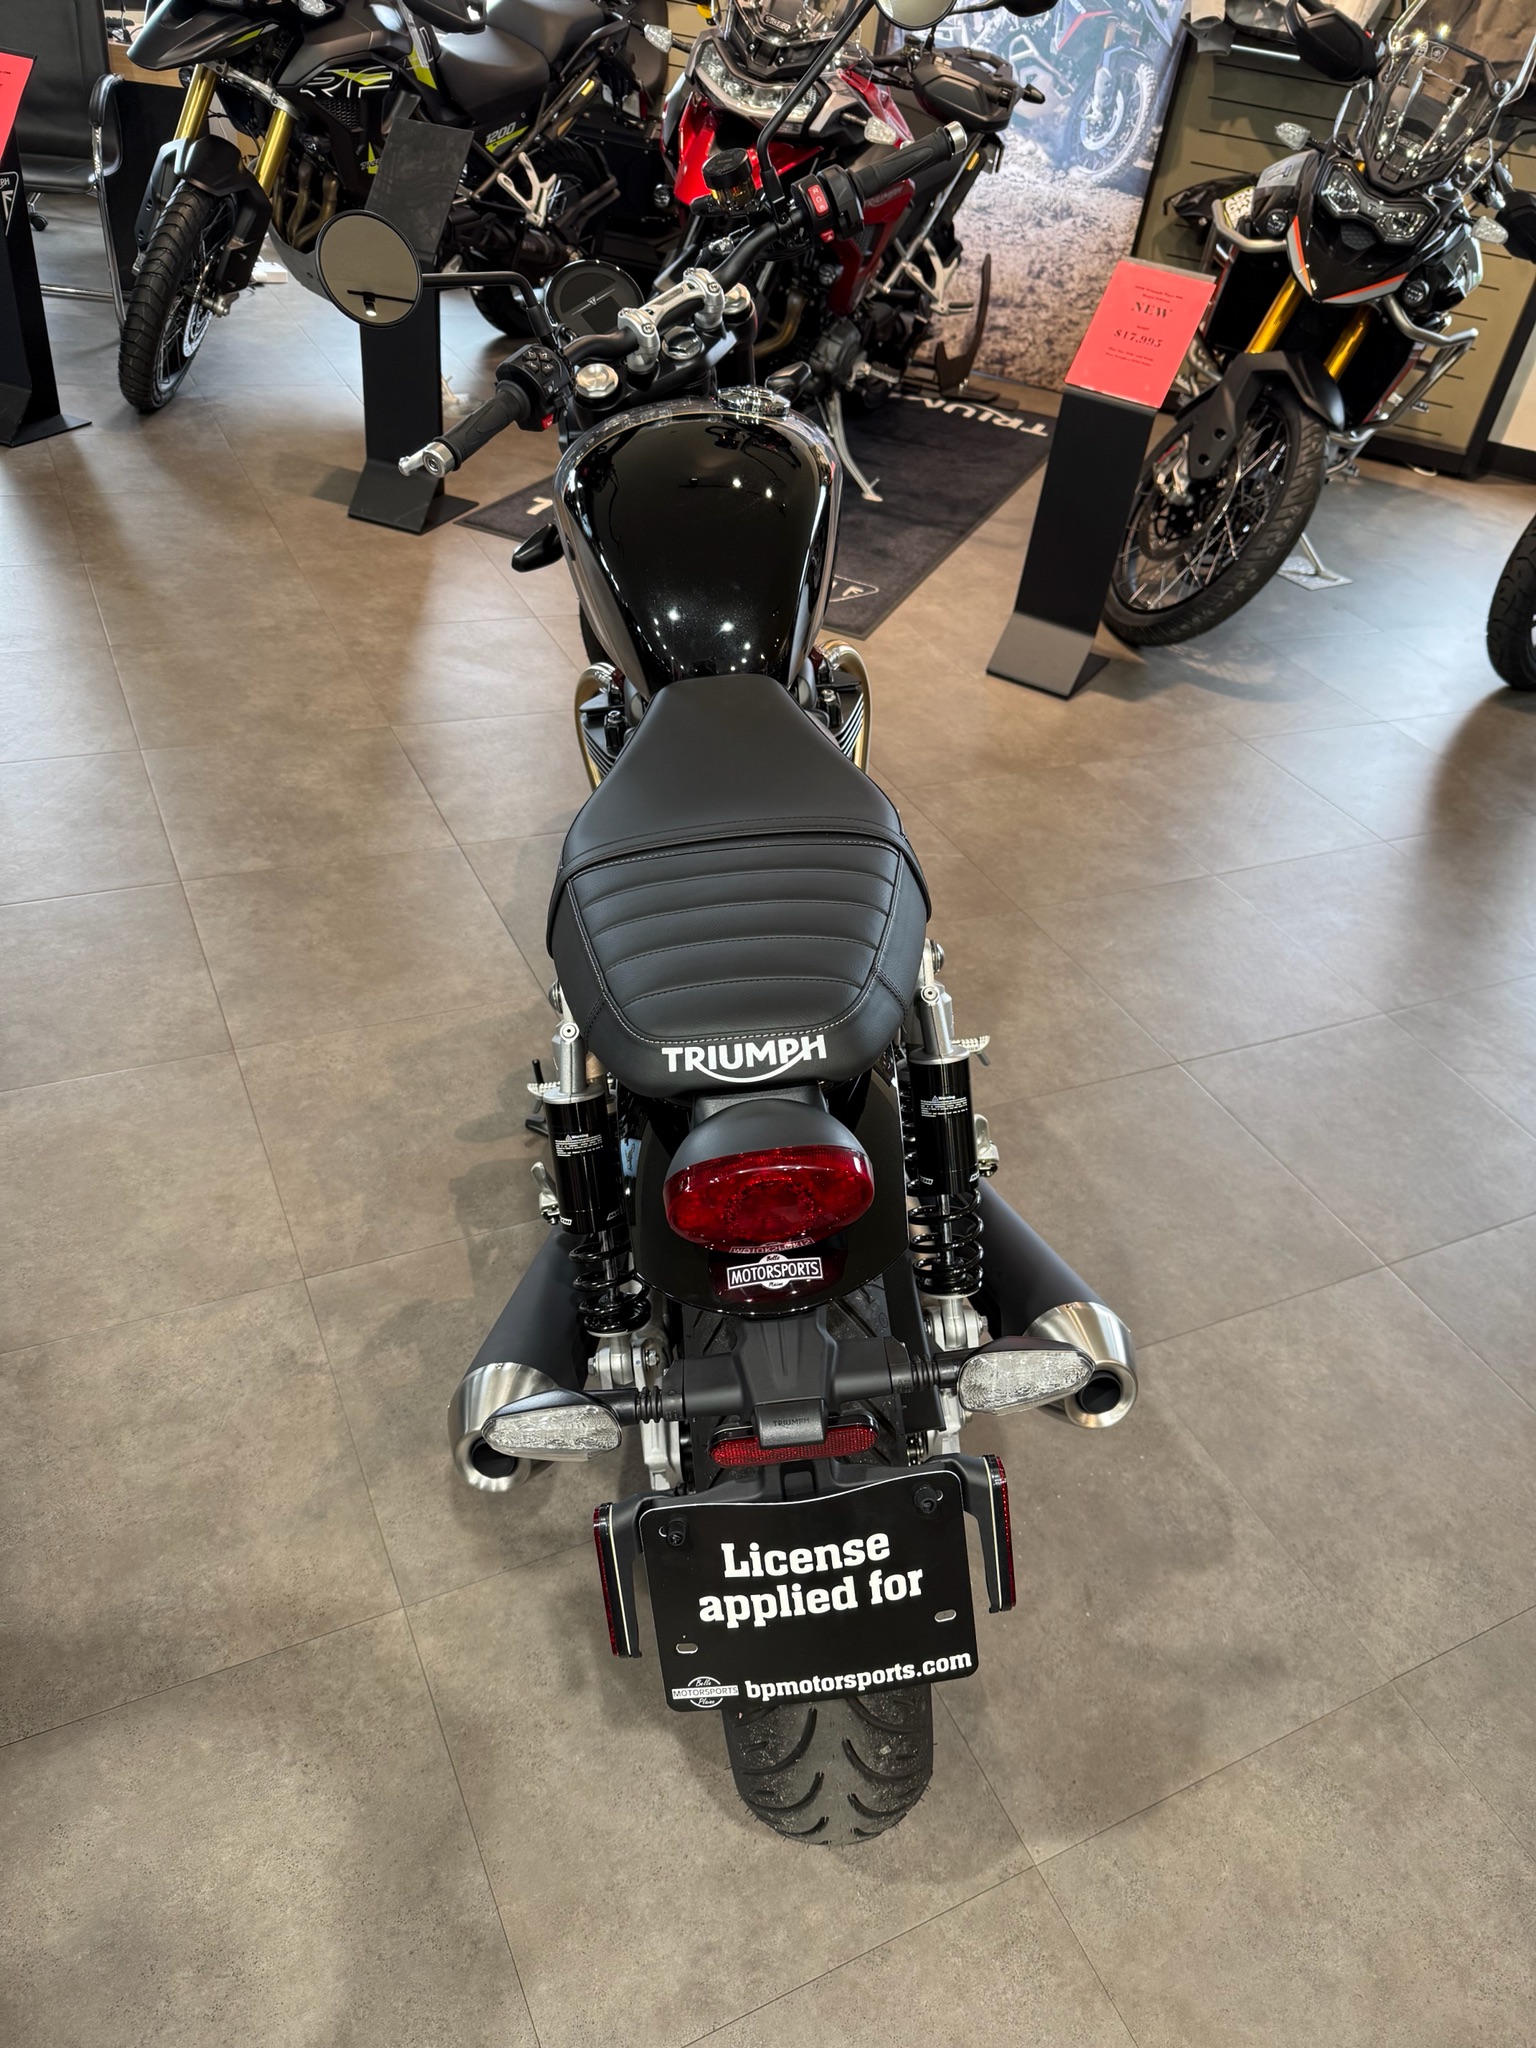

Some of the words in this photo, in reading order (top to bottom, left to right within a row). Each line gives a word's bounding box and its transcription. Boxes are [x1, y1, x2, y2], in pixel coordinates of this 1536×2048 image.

[485, 121, 517, 145] 1200
[1131, 301, 1173, 319] NEW
[1114, 329, 1164, 348] $17,995
[661, 1034, 828, 1084] TRIUMPH
[731, 1261, 819, 1286] MOTORSPORTS
[773, 1417, 810, 1427] TRIUMPH
[720, 1532, 891, 1578] License
[698, 1575, 859, 1629] applied
[868, 1568, 924, 1605] for
[695, 1678, 712, 1687] Belle
[744, 1651, 973, 1702] bpmotorsports.com
[673, 1686, 739, 1698] MOTORSPORTS
